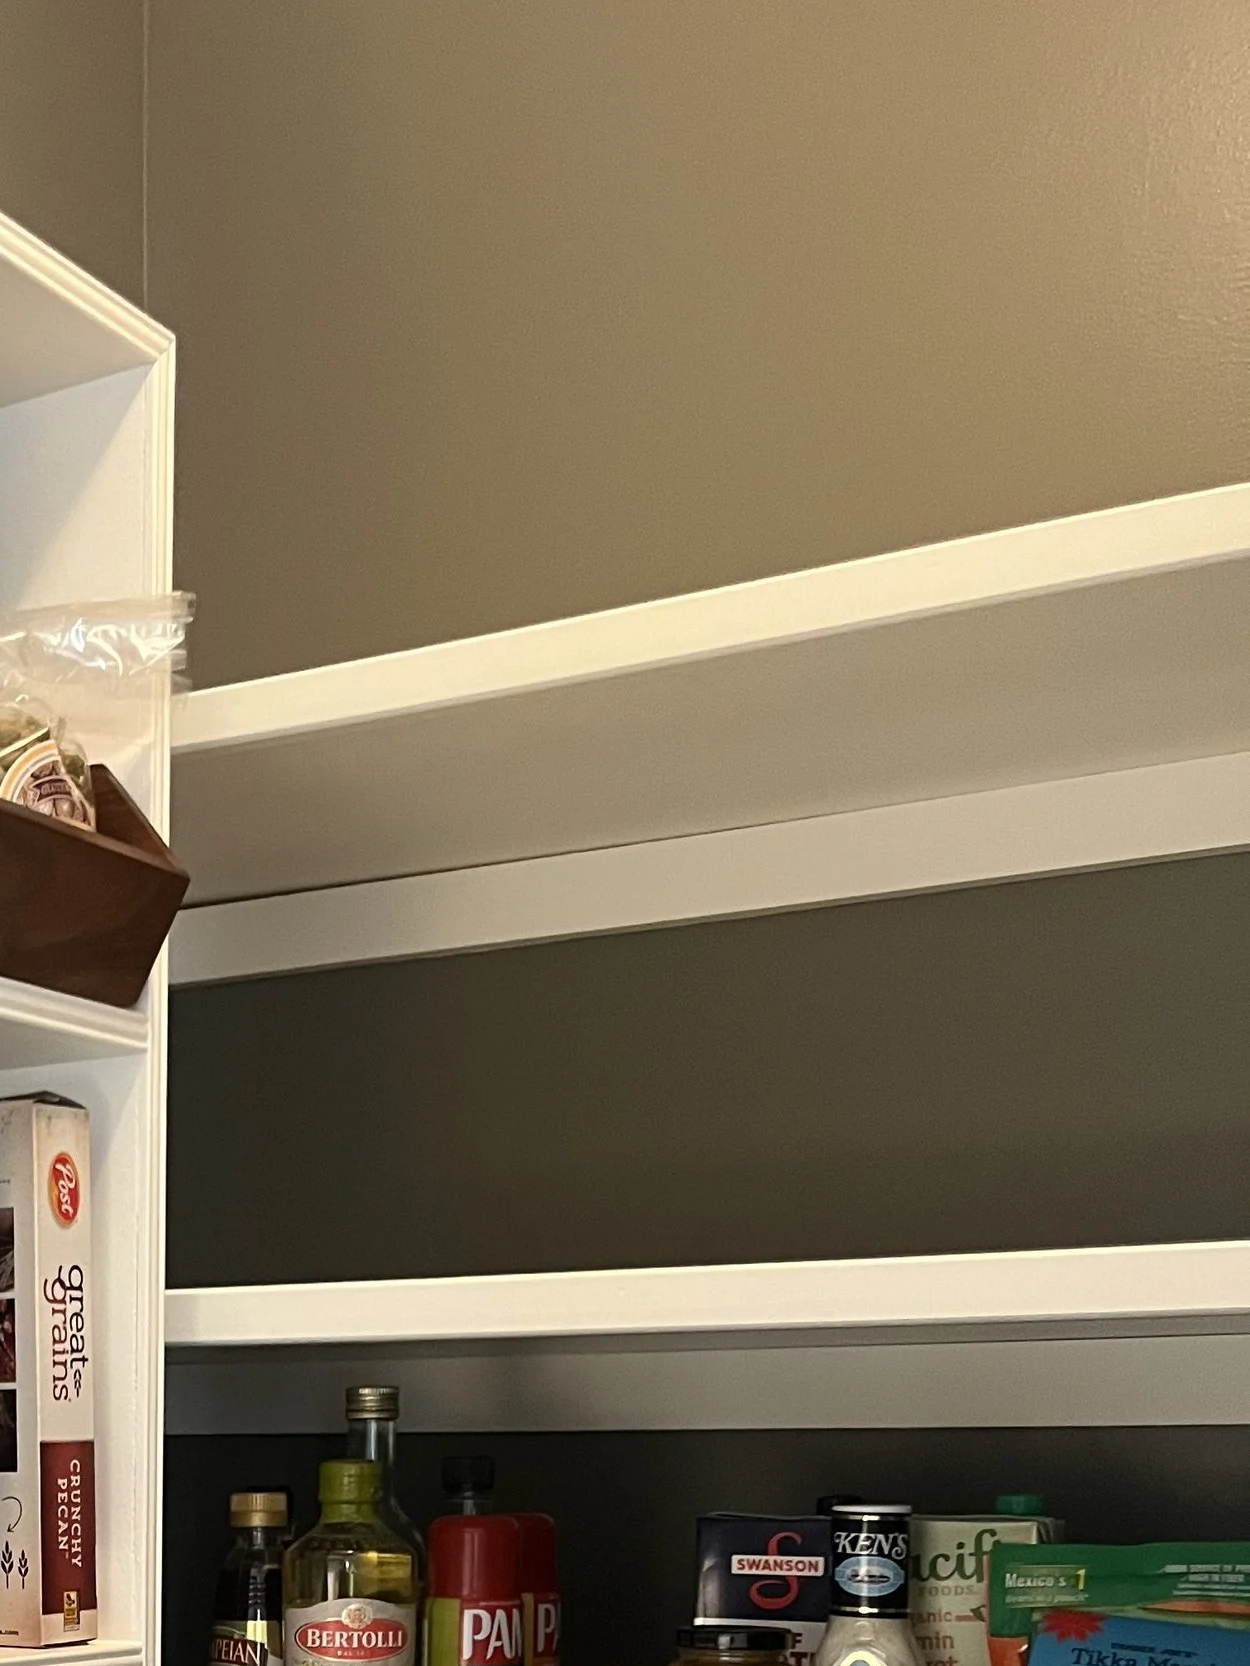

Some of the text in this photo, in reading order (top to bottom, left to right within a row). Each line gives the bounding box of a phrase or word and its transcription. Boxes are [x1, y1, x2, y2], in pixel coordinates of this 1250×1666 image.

[54, 1162, 76, 1221] Post
[44, 1265, 70, 1402] grains
[67, 1265, 88, 1369] great
[57, 1478, 68, 1552] PECAN
[69, 1459, 82, 1567] CRUNCHY
[833, 1531, 908, 1560] KEN'S
[736, 1558, 819, 1573] SWANSON
[306, 1628, 403, 1648] BERTOLLI
